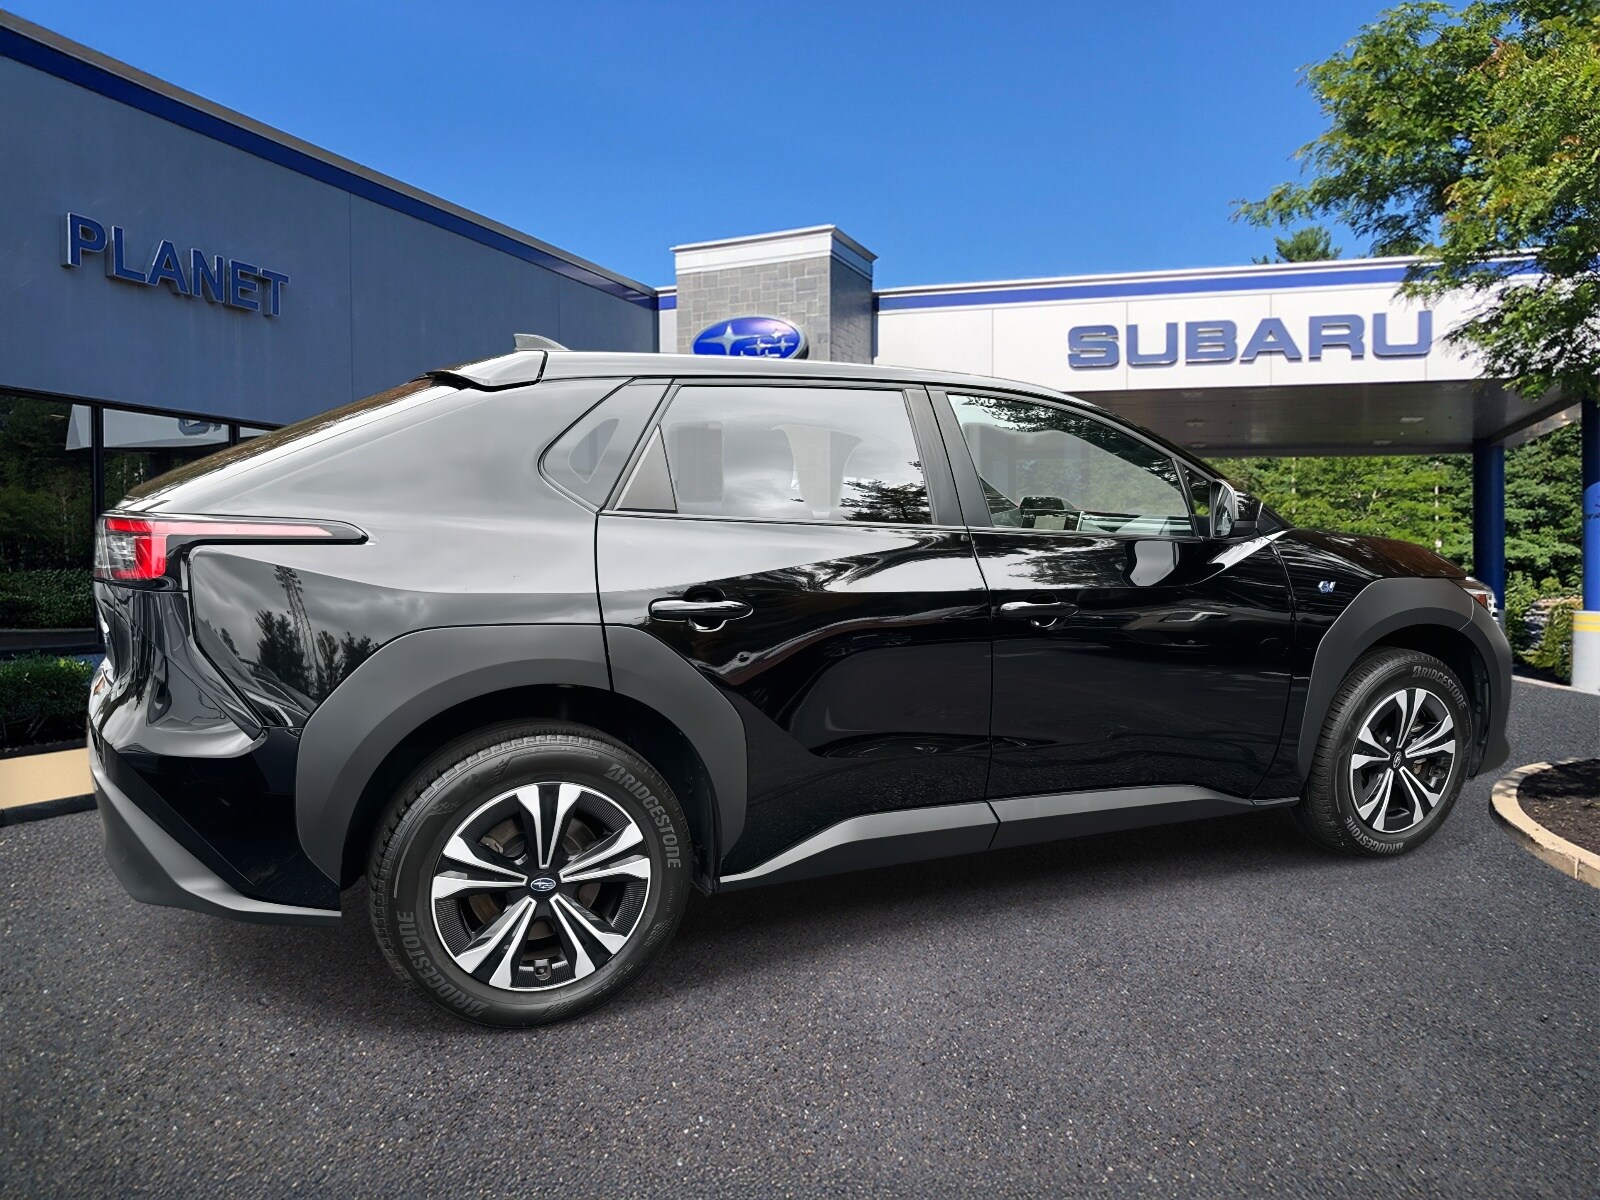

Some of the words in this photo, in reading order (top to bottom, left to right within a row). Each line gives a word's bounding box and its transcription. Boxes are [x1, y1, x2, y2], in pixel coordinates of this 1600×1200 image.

[61, 211, 290, 317] PLANET
[1067, 309, 1433, 371] SUBARU
[1412, 665, 1467, 710] BRIDGESTONE
[603, 763, 681, 868] BRIDGESTONE
[396, 911, 489, 1017] BRIDGESTONE
